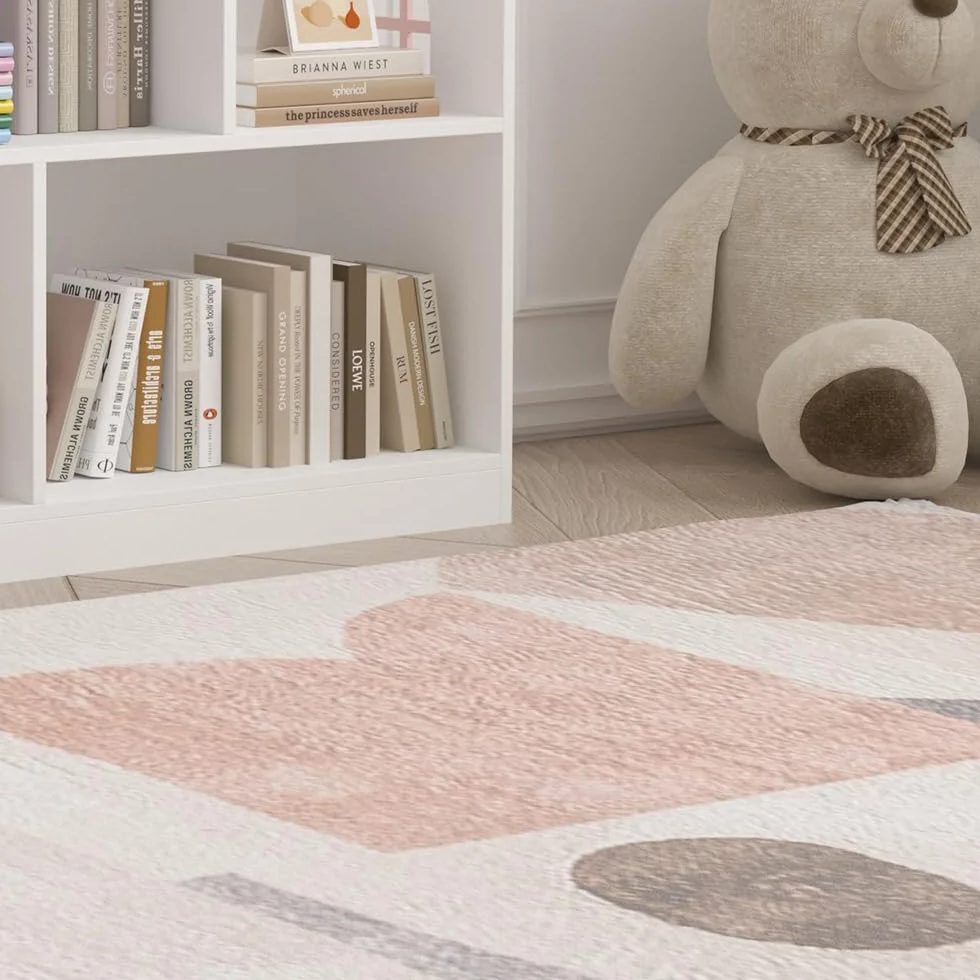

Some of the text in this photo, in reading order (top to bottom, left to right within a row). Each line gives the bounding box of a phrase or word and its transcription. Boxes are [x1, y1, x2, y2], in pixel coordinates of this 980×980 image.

[292, 59, 388, 74] BRIANNA WIEST
[421, 279, 441, 355] LOST FISH
[278, 311, 287, 411] GRAND OPENING
[331, 332, 340, 411] CONSIDERED
[351, 350, 363, 391] LOEWE
[395, 355, 408, 384] RUM
[408, 321, 425, 406] DANISH MODERN DESIGN
